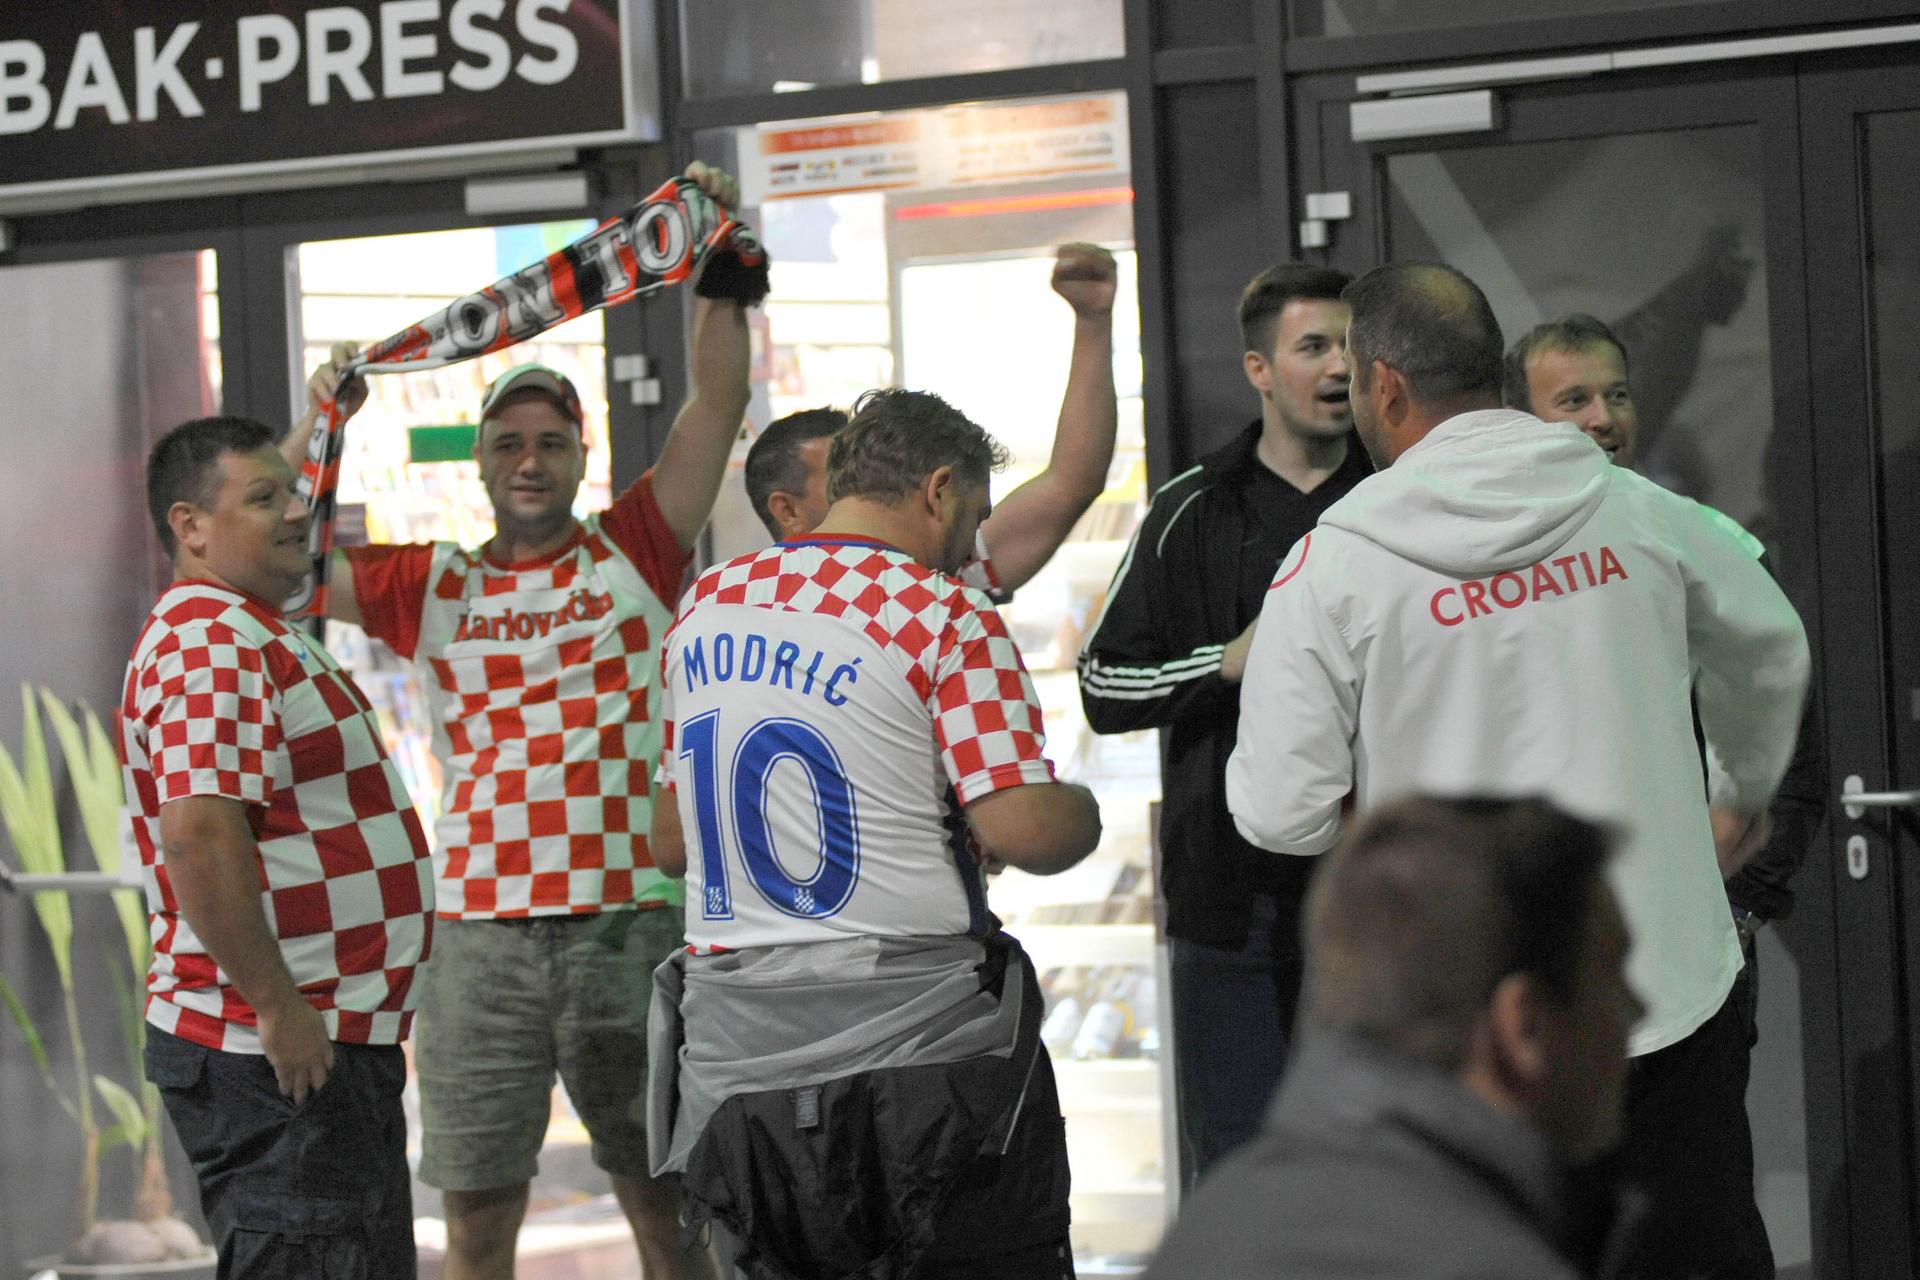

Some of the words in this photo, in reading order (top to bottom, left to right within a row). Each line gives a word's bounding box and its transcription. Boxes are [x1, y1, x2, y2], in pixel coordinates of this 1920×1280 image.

[1430, 546, 1628, 627] CROATIA
[683, 632, 862, 707] MODRIĆ
[679, 707, 861, 920] 10
